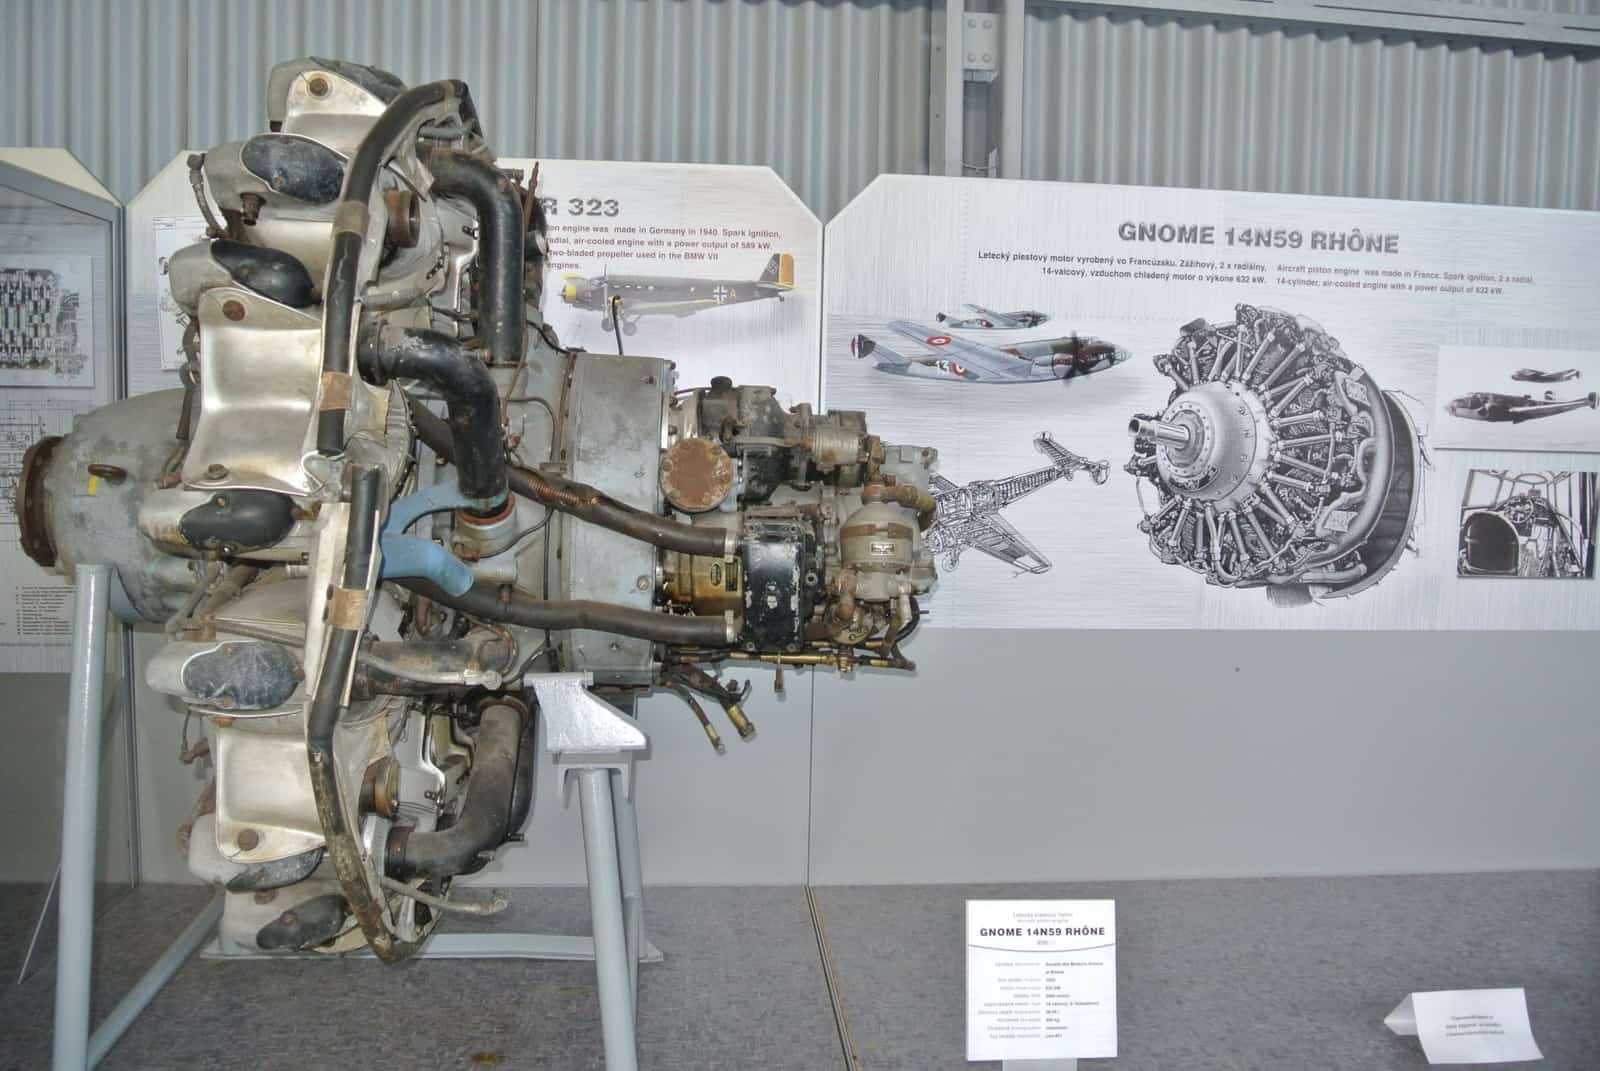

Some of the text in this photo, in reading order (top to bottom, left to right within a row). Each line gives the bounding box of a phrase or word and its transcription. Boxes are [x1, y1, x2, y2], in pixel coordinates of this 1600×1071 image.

[568, 198, 619, 217] 323
[562, 225, 590, 235] engine
[614, 225, 636, 233] made
[639, 225, 647, 233] in
[649, 226, 686, 237] Germany
[689, 227, 696, 236] in
[722, 228, 746, 239] Spark
[748, 229, 782, 241] ignition,
[1118, 222, 1399, 254] GNOME 14N59 RHÔNE
[574, 237, 615, 246] air-cooled
[617, 239, 645, 249] engine
[647, 238, 664, 247] with
[674, 240, 699, 250] power
[702, 240, 728, 251] output
[731, 240, 739, 249] of
[548, 248, 594, 257] two-bladed
[596, 249, 634, 260] propeller
[636, 250, 656, 259] used
[658, 250, 666, 259] in
[669, 250, 682, 259] the
[684, 251, 705, 260] BMW
[978, 249, 1011, 262] Letecký
[1050, 253, 1075, 263] motor
[1077, 254, 1115, 266] vyrobený
[1116, 257, 1127, 265] vo
[1090, 267, 1132, 278] vzduchom
[1134, 270, 1170, 282] chladený
[1172, 271, 1196, 281] motor
[1276, 264, 1306, 273] Aircraft
[1308, 265, 1332, 275] piston
[1334, 267, 1360, 276] engine
[1364, 269, 1379, 277] was
[1381, 268, 1402, 278] made
[1404, 269, 1412, 278] in
[1443, 270, 1465, 282] Spark
[1323, 279, 1361, 289] air-cooled
[1362, 280, 1388, 291] engine
[1390, 281, 1406, 290] with
[1414, 283, 1438, 293] power
[1440, 284, 1464, 295] output
[1466, 284, 1474, 293] of
[936, 360, 950, 375] 13
[980, 925, 1105, 937] GNOME 14N59 RHÔNE
